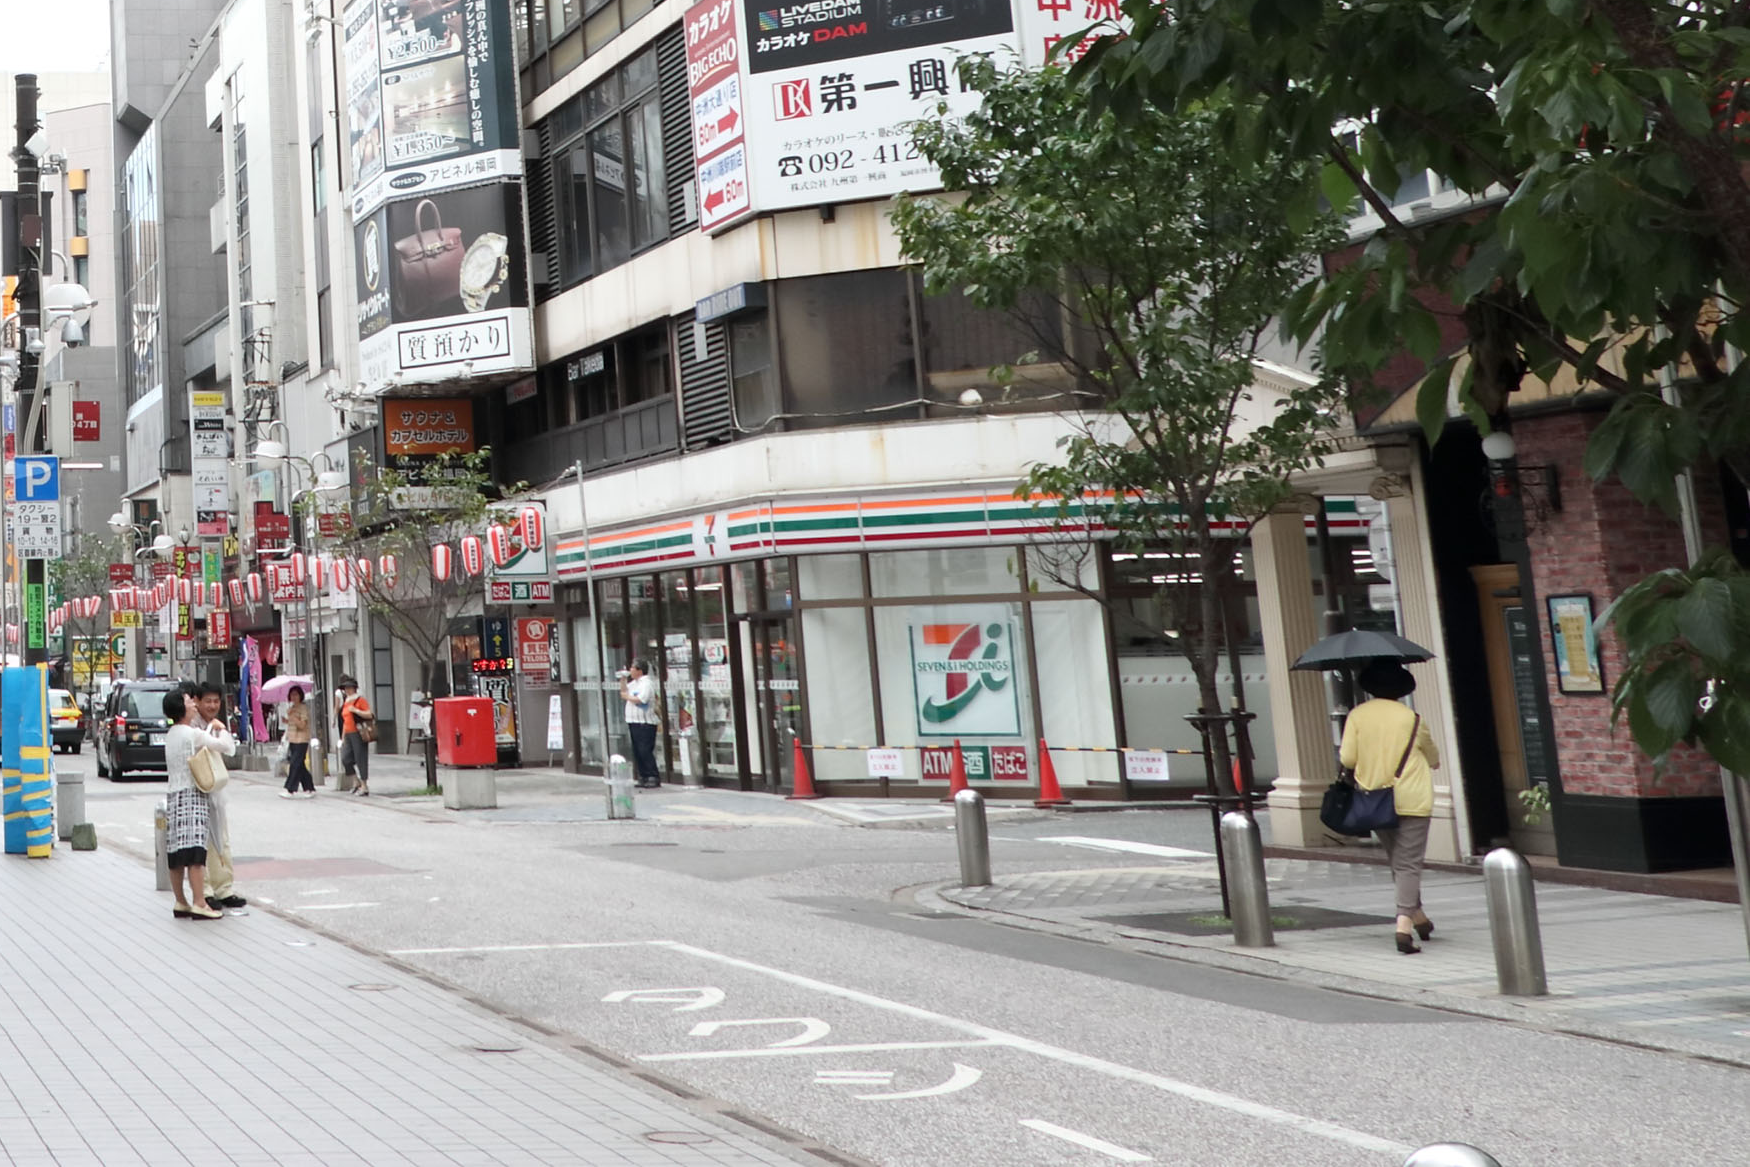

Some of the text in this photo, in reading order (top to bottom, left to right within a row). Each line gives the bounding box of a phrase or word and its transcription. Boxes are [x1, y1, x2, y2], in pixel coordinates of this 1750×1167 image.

[689, 0, 732, 47] カラオケ
[780, 5, 862, 28] STADIUM
[756, 22, 867, 54] カラオケ DAM
[429, 157, 497, 183] アビネル福岡
[407, 325, 500, 362] 質預かり
[25, 460, 52, 498] P
[19, 505, 55, 515] タクシー
[514, 584, 528, 598] 酒
[532, 586, 550, 597] ATM
[960, 660, 1008, 671] HOLDINGS
[923, 751, 1027, 775] ATM 酒 たばこ
